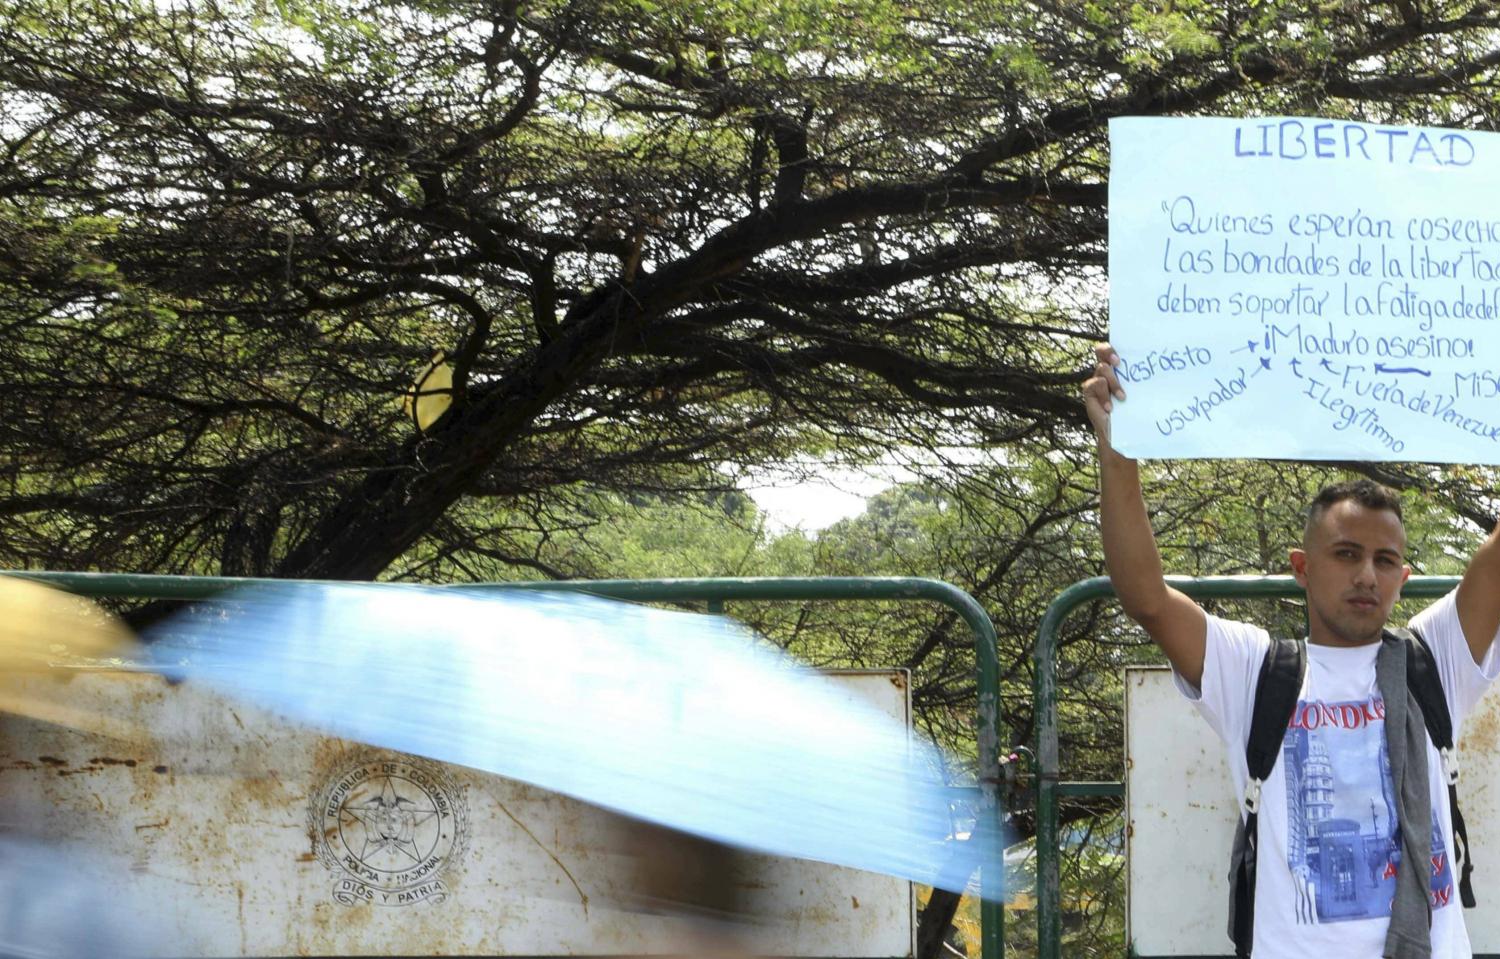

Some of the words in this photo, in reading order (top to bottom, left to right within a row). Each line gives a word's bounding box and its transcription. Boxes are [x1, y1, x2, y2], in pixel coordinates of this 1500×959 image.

[1234, 120, 1475, 167] LIBERTAD
[1289, 208, 1394, 244] esperan
[1163, 237, 1214, 274] las
[1223, 238, 1340, 277] bondades
[1348, 243, 1372, 277] de
[1381, 243, 1404, 278] la
[1157, 281, 1221, 313] deben
[1228, 282, 1330, 323] soportar
[1376, 334, 1475, 358] asesino!
[1341, 365, 1411, 409] Fuera
[1407, 389, 1431, 413] de
[327, 767, 370, 818] REPUBLICA
[381, 764, 397, 774] DE
[409, 769, 449, 820] COLOMBIA
[342, 881, 374, 899] DIOS
[382, 894, 390, 903] Y
[398, 881, 442, 904] PATRIA
